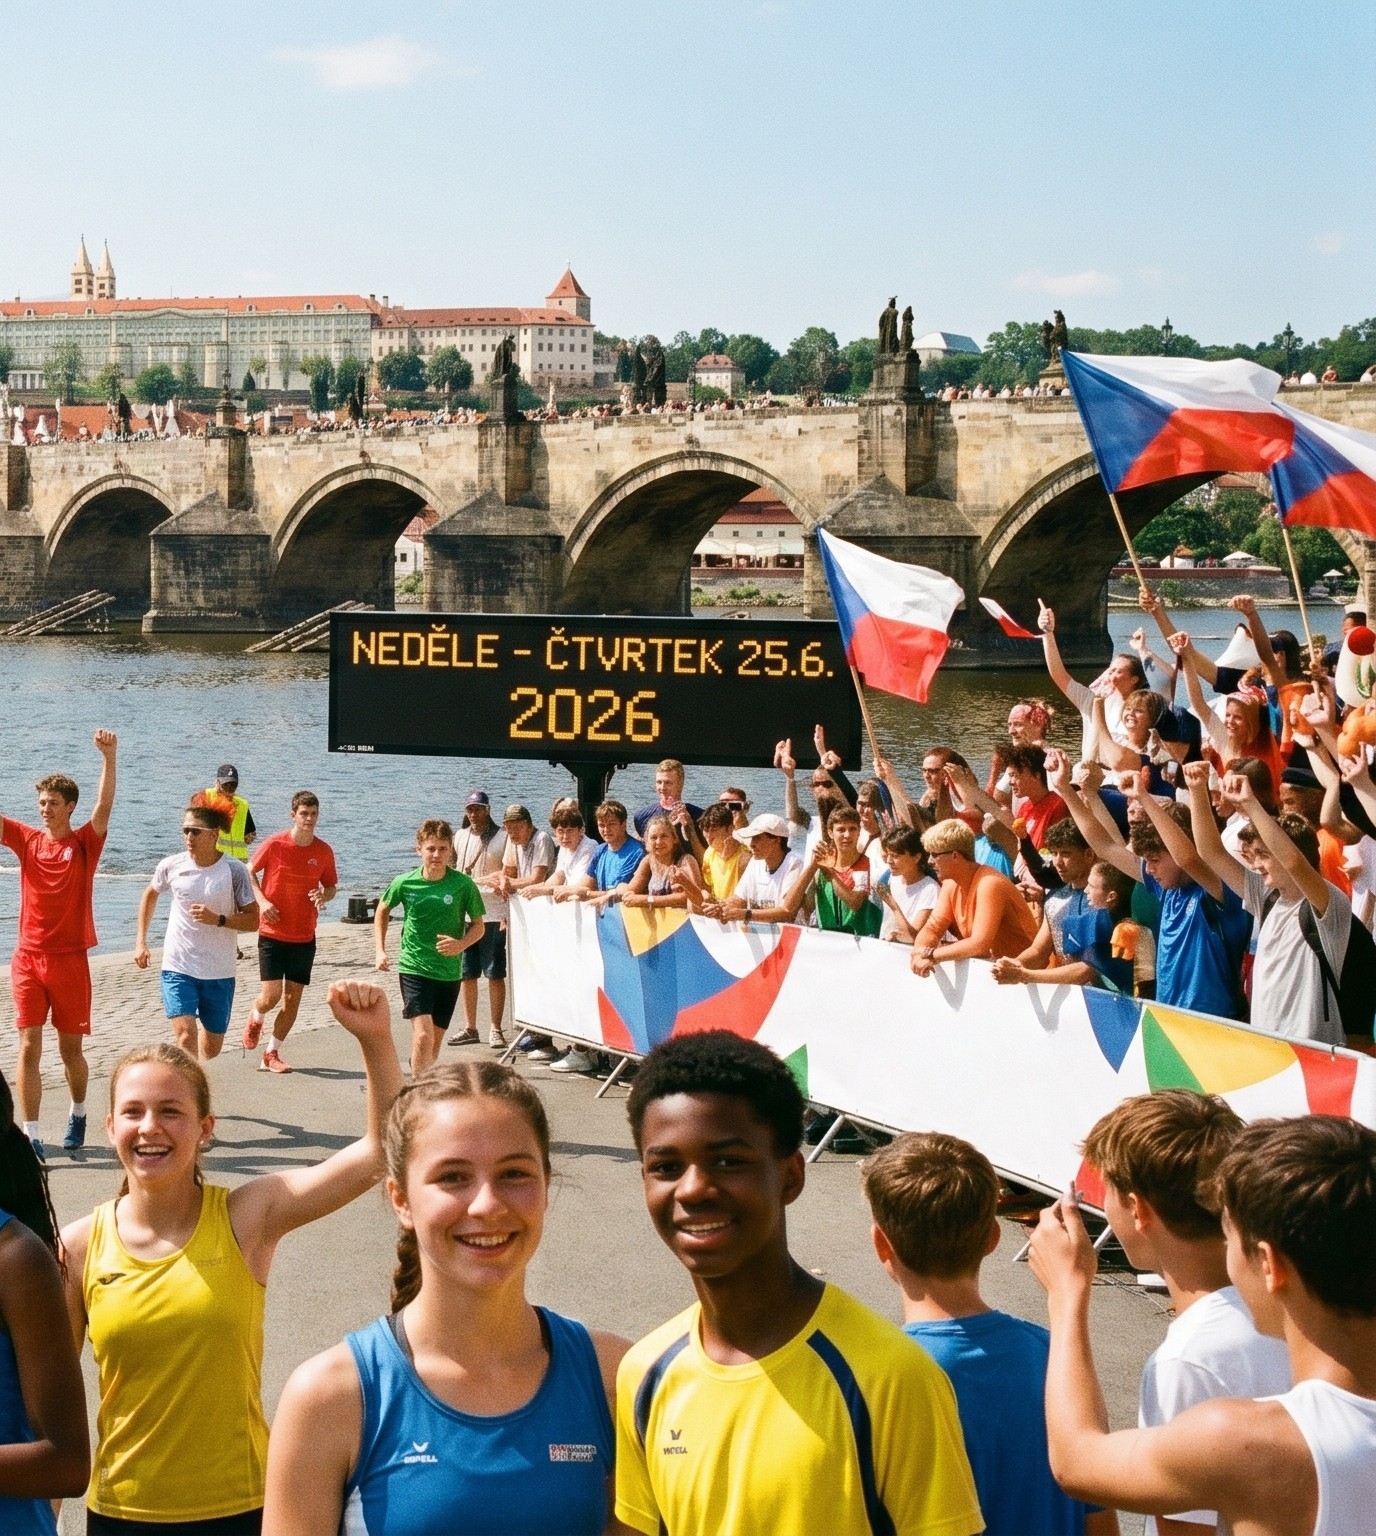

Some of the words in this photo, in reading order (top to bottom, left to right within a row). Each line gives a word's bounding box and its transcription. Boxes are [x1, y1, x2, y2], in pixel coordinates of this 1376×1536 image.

[352, 623, 499, 668] NEDĚLE
[545, 627, 723, 674] ČTVRTEK
[737, 640, 834, 677] 25.6.
[509, 687, 660, 742] 2026
